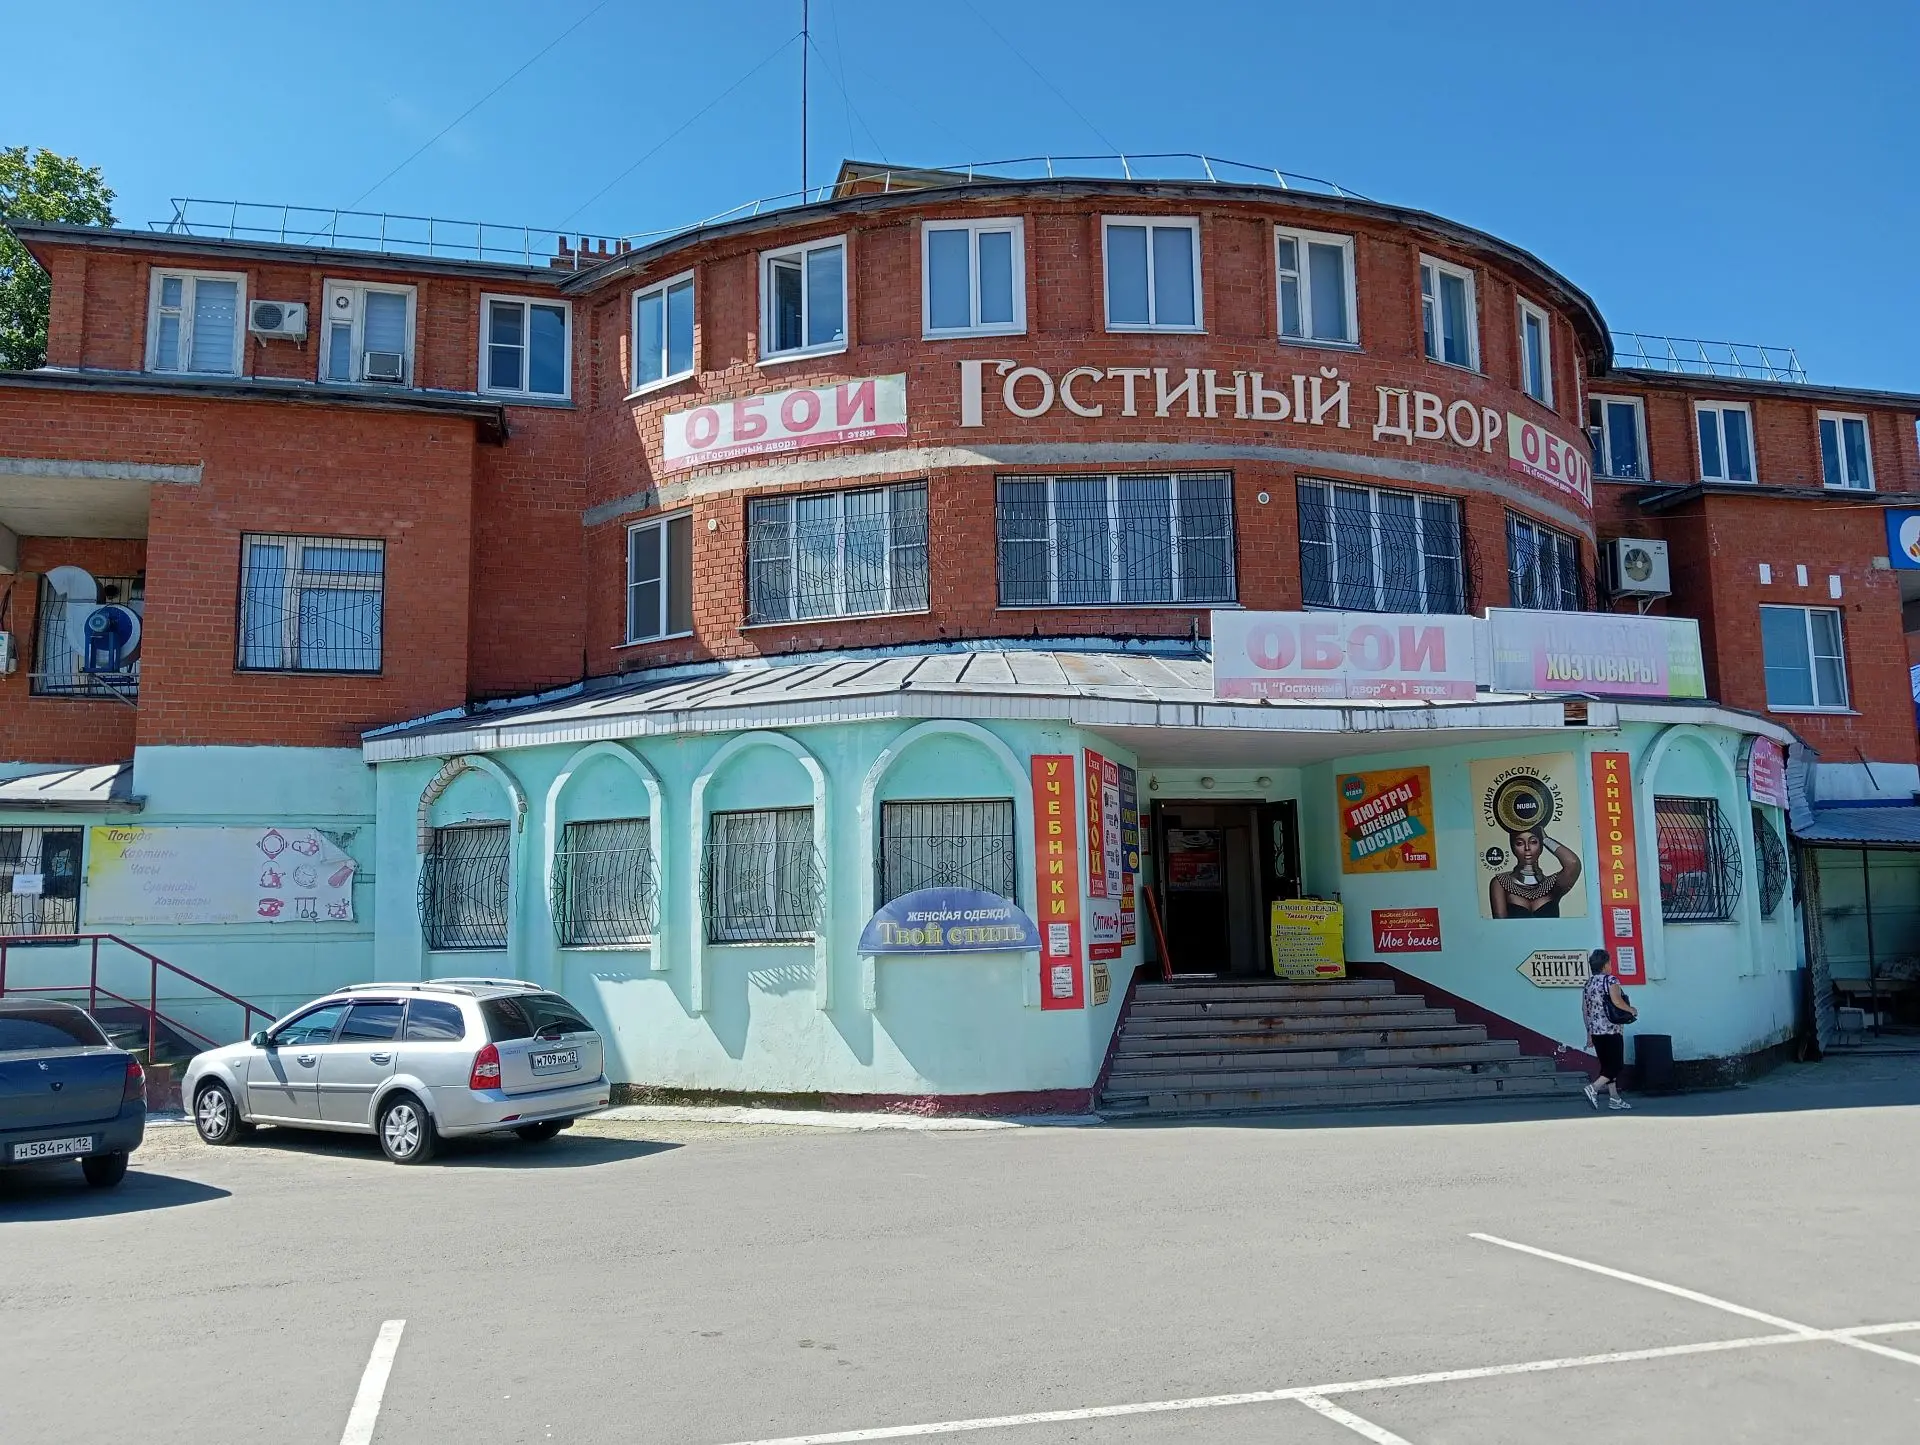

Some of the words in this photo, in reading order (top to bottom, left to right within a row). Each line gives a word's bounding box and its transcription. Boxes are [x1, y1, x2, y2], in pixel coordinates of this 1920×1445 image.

[685, 380, 876, 450] ОБОИ
[685, 455, 698, 465] ТЦ
[765, 439, 797, 453] двор»
[837, 431, 843, 440] 1
[847, 428, 876, 439] этаж
[1521, 423, 1589, 499] ОБОИ
[1246, 623, 1447, 673] ОБОИ
[1545, 653, 1659, 684] ХОЗТОВАРЫ
[1251, 682, 1268, 696] ТЦ
[1401, 683, 1407, 694] 1
[1413, 685, 1447, 695] этаж
[1350, 783, 1413, 826] ЛЮСТРЫ
[1484, 786, 1496, 828] СТУДИЯ
[1493, 766, 1540, 786] КРАСОТЫ
[1542, 774, 1551, 783] И
[1549, 783, 1564, 822] ЗАГАРА
[1516, 802, 1537, 810] NUBIA
[1089, 774, 1102, 875] ОБОИ
[1359, 807, 1407, 836] КЛЕЁНКА
[1605, 759, 1628, 899] КАНЦТОВАРЫ
[1046, 762, 1066, 915] УЧЕБНИКИ
[1356, 820, 1414, 856] ПОСУДА
[1491, 848, 1498, 857] 4
[1404, 853, 1410, 862] 1
[907, 911, 961, 921] ЖЕНСКАЯ
[964, 907, 1011, 920] ОДЕЖДА
[878, 922, 943, 945] Твой
[1378, 931, 1405, 949] Мое
[1407, 930, 1440, 947] белье
[1531, 961, 1585, 977] КНИГИ
[568, 1051, 576, 1062] 12
[76, 1138, 88, 1148] 12
